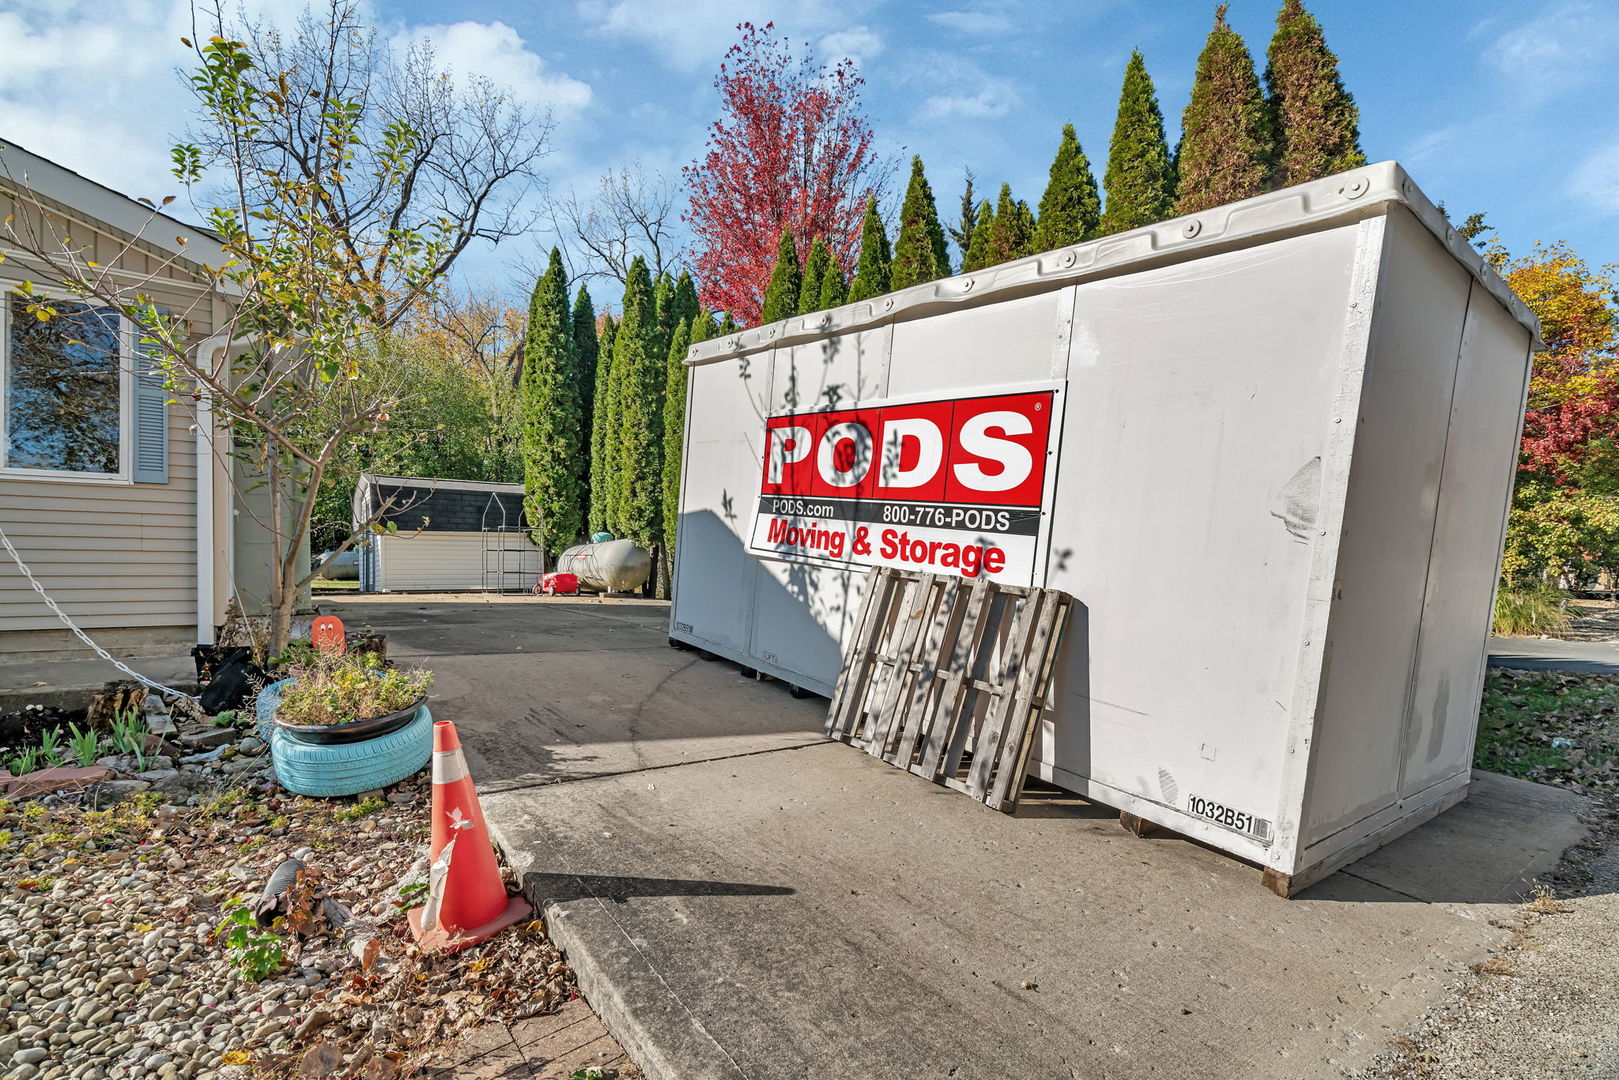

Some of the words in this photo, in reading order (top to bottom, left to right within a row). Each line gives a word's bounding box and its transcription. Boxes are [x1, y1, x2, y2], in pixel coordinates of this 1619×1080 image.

[767, 411, 1034, 492] PODS
[772, 498, 835, 518] PODS.com
[883, 506, 1011, 531] 800-776-PODS
[767, 518, 846, 558] Moving
[851, 526, 872, 556] &
[880, 528, 1006, 578] Storage
[1190, 796, 1253, 833] 1032B51
